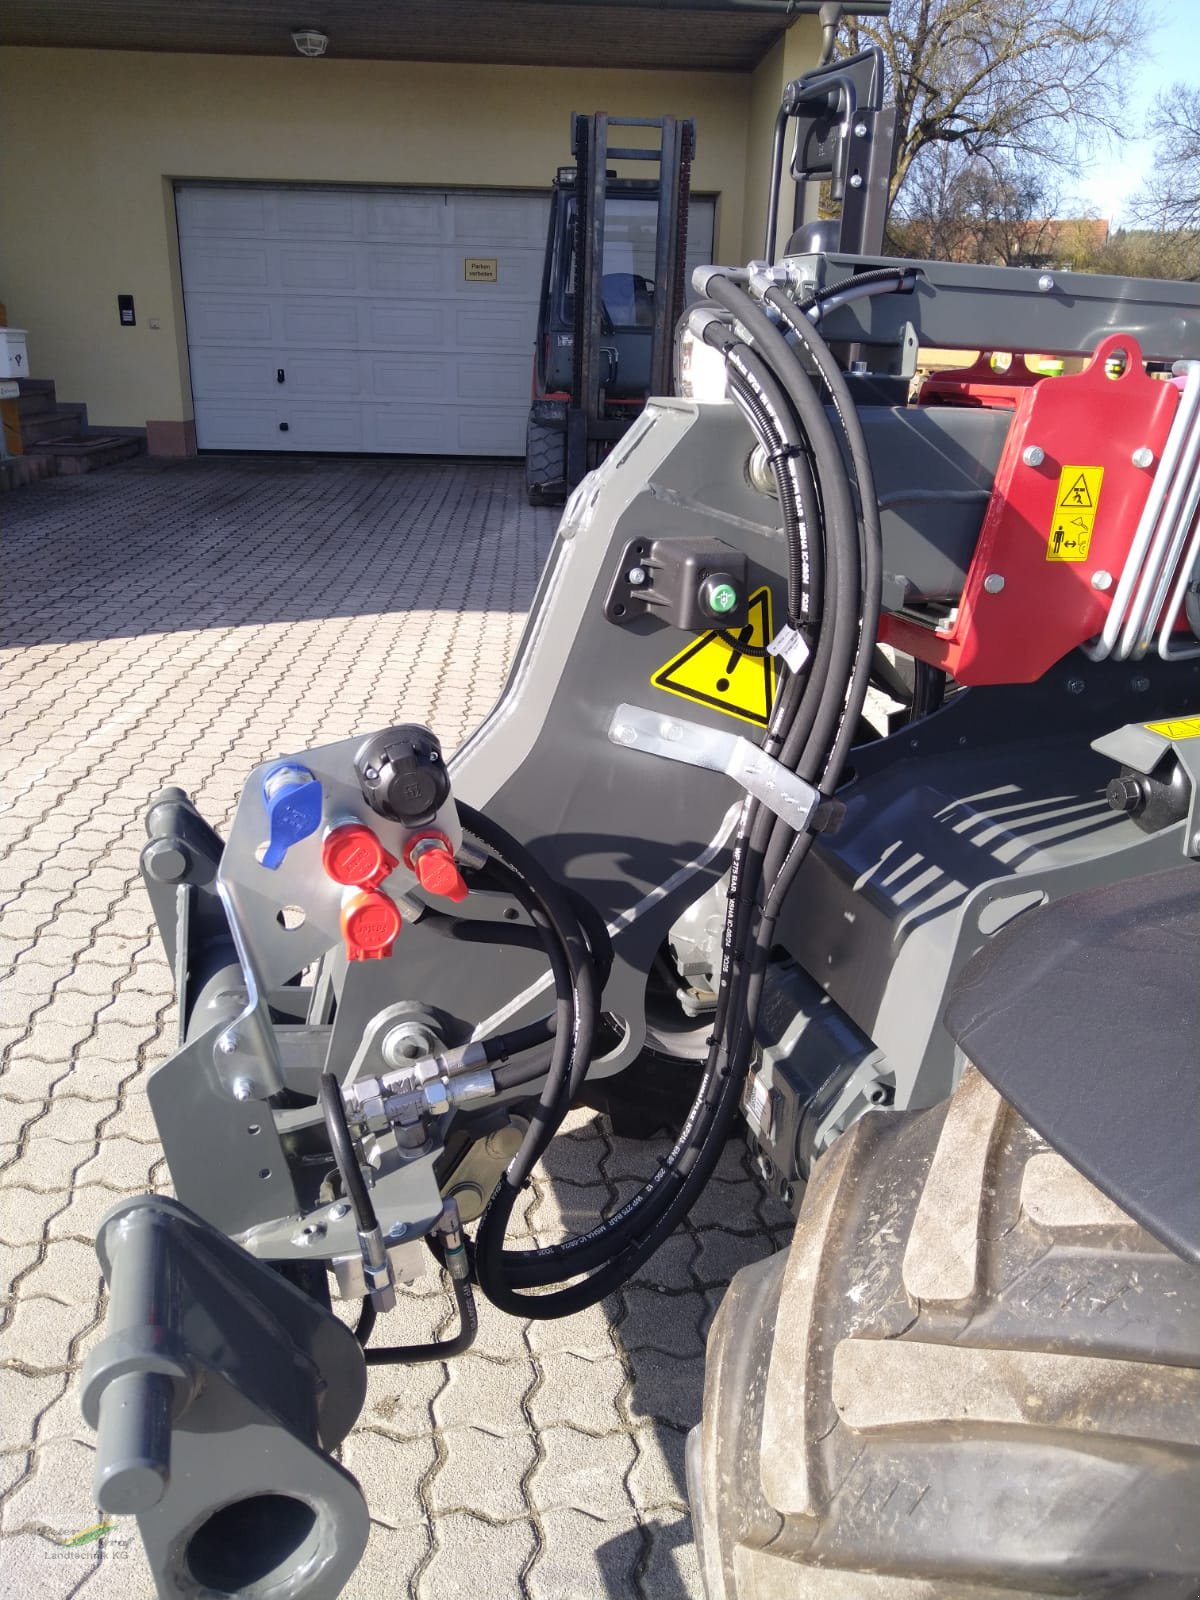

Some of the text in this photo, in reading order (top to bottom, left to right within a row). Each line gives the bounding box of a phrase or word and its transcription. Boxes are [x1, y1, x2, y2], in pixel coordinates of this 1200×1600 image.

[733, 847, 742, 861] WP
[732, 860, 740, 875] 275
[730, 874, 738, 892] BAR
[608, 1213, 623, 1226] BAR
